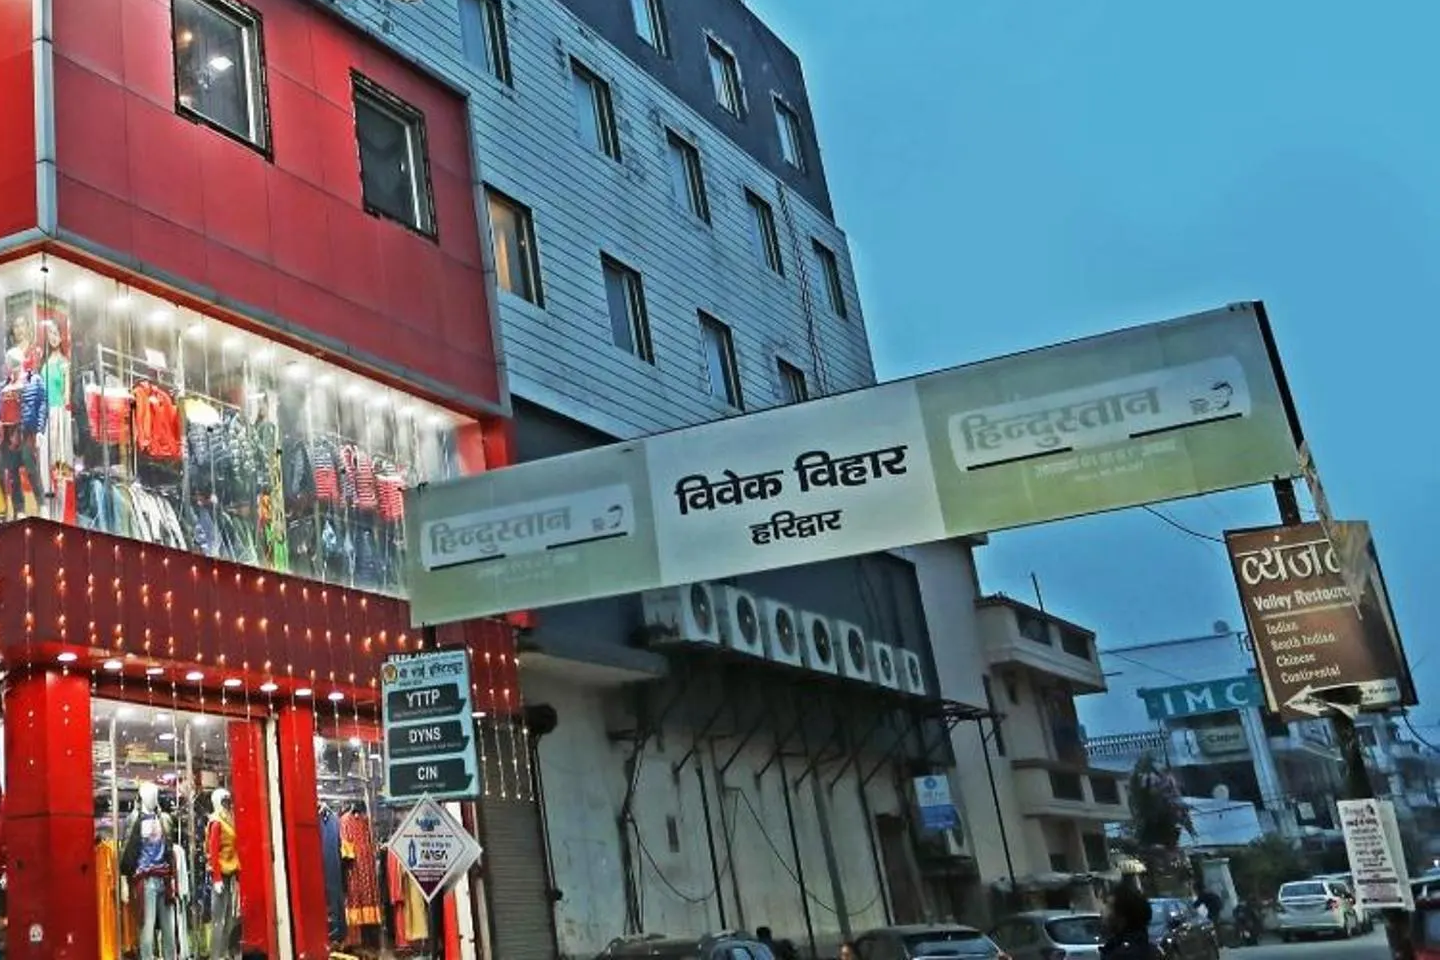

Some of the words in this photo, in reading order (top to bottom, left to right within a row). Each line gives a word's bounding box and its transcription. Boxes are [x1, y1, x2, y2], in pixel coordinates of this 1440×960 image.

[961, 386, 1162, 453] हिन्दुस्तान
[674, 469, 784, 515] विवेक
[793, 445, 908, 492] विहार
[429, 506, 571, 556] हिन्दुस्तान
[750, 509, 843, 545] हरिद्वार
[1253, 593, 1292, 611] Valley
[1265, 621, 1299, 635] Indian
[1276, 653, 1317, 668] Chinese
[1280, 664, 1341, 684] Continental
[406, 688, 441, 707] YTTP
[408, 726, 442, 744] DYNS
[417, 765, 438, 781] CIN
